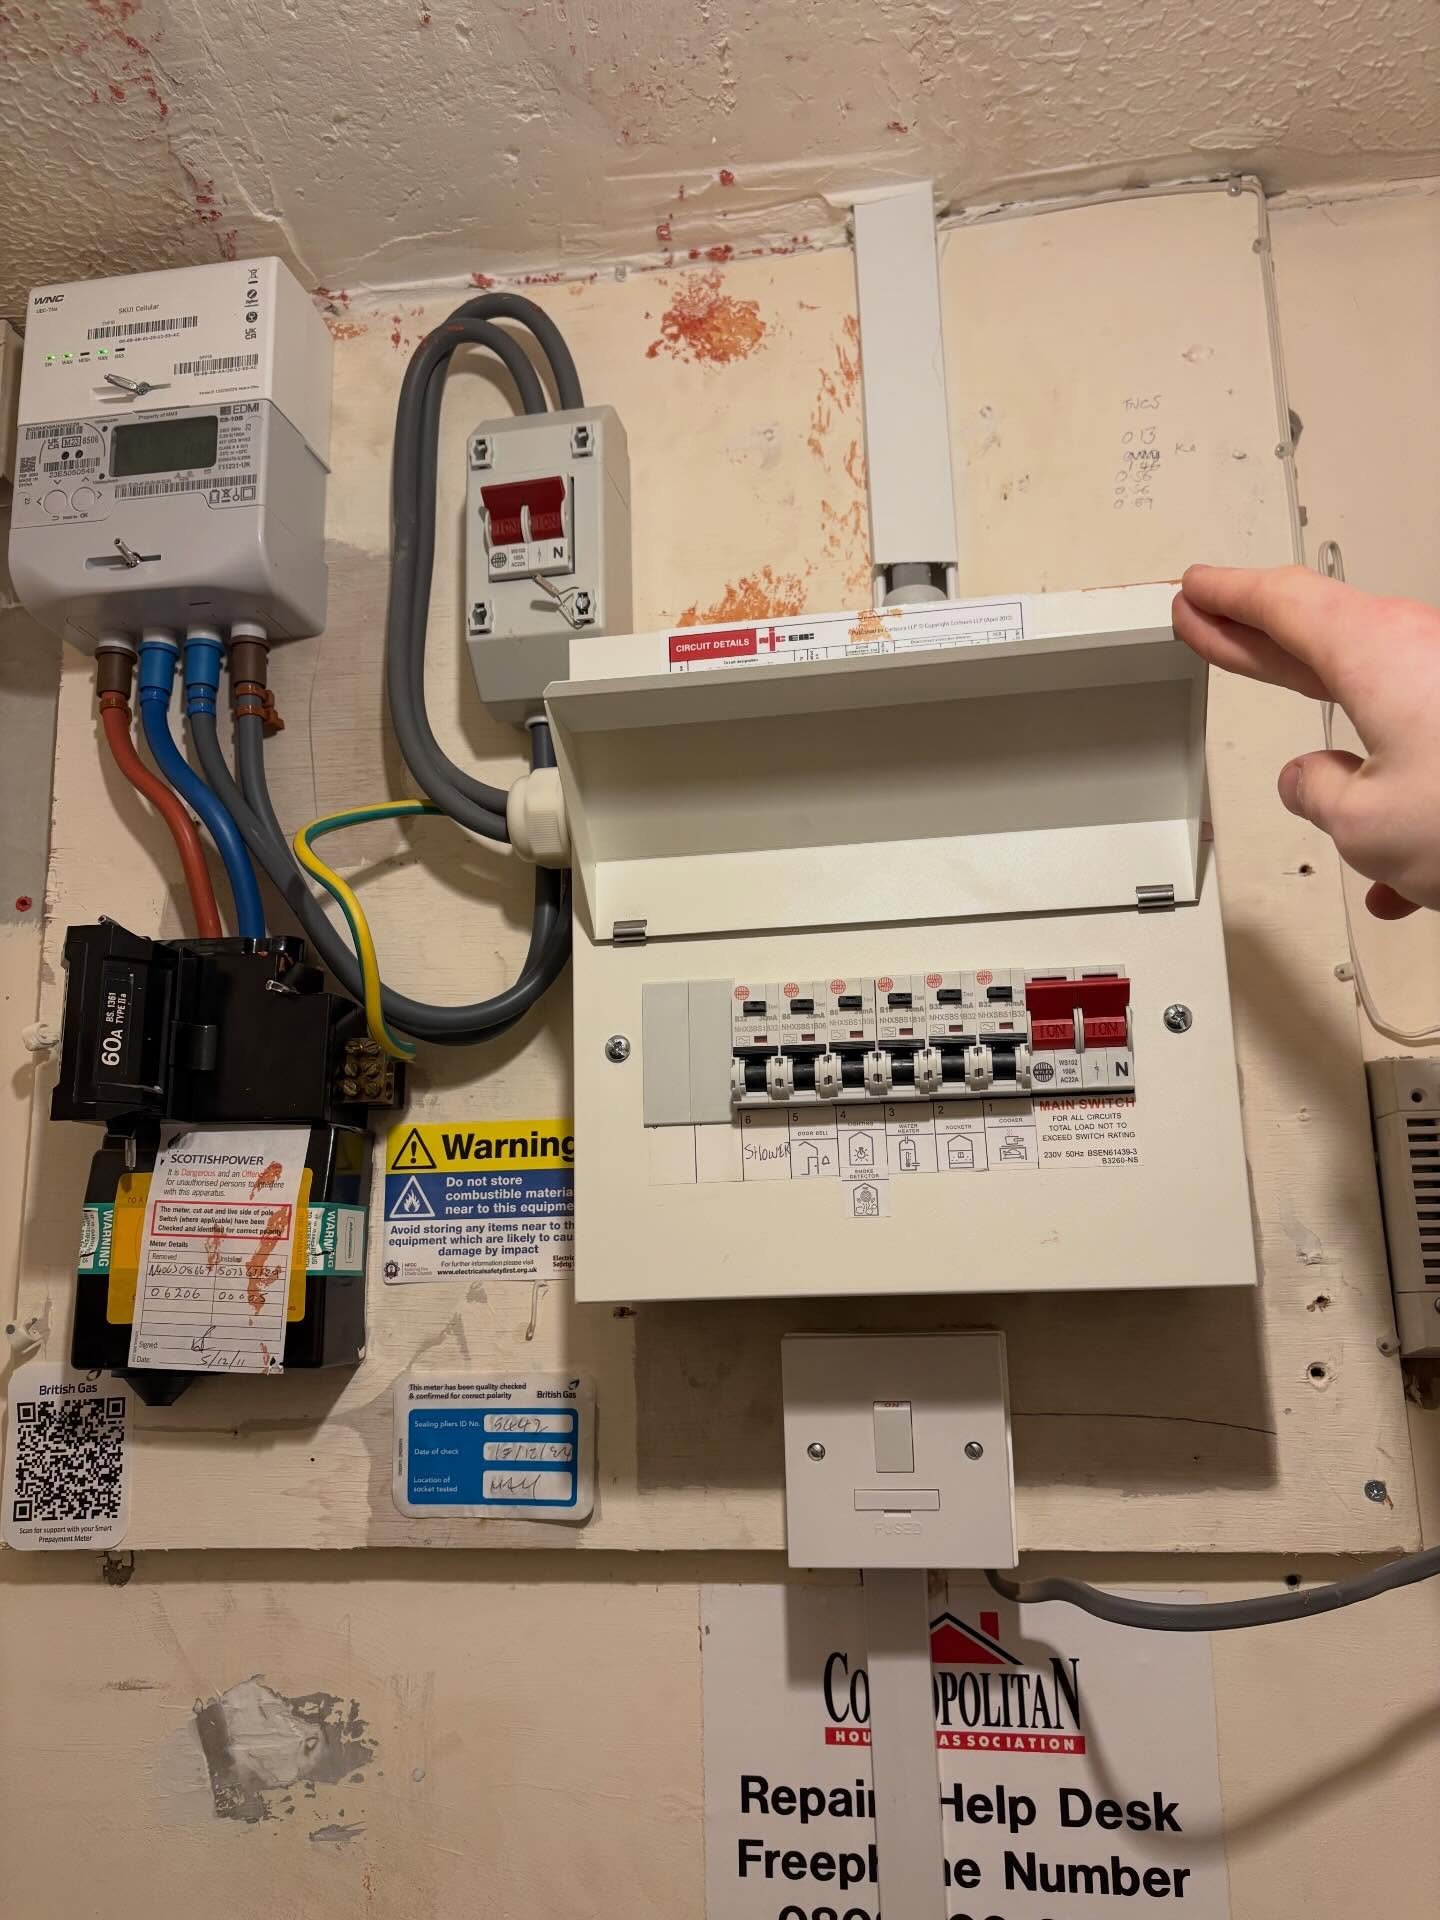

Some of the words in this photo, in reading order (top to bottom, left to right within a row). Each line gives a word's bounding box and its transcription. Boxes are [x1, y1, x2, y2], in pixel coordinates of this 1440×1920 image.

[34, 295, 64, 305] WNC
[233, 403, 259, 414] EDMI
[64, 437, 80, 447] M23
[553, 546, 563, 559] N
[676, 643, 711, 653] CIRCUIT
[713, 638, 750, 649] DETAILS
[107, 992, 116, 1008] 1361
[116, 1005, 126, 1024] TYPE
[978, 1011, 1025, 1019] NHXSBS1B32
[101, 1029, 123, 1066] 60A
[1115, 1061, 1129, 1077] N
[938, 1105, 944, 1114] 2
[988, 1103, 993, 1112] 1
[1039, 1099, 1075, 1112] MAIN
[1079, 1096, 1137, 1110] SWITCH
[792, 1112, 799, 1121] 5
[840, 1111, 846, 1119] 4
[889, 1107, 895, 1116] 3
[1052, 1114, 1068, 1122] FOR
[1087, 1112, 1122, 1120] CIRCUITS
[745, 1115, 752, 1125] 6
[1049, 1124, 1072, 1132] TOTAL
[1074, 1123, 1094, 1131] LOAD
[1042, 1134, 1073, 1142] EXCEED
[441, 1130, 574, 1162] Warning
[744, 1143, 791, 1161] SHOWER
[1043, 1151, 1062, 1159] 230V
[1065, 1150, 1084, 1158] 50Hz
[1087, 1148, 1138, 1157] BSEN61439-3
[170, 1154, 264, 1165] SCOTTISHPOWER
[181, 1168, 216, 1178] Dangerous
[218, 1169, 230, 1177] and
[176, 1179, 218, 1187] unauthorised
[446, 1177, 463, 1187] Do
[467, 1176, 486, 1186] not
[491, 1175, 523, 1186] store
[163, 1188, 177, 1196] with
[178, 1188, 190, 1196] this
[191, 1189, 226, 1198] apparatus.
[445, 1189, 521, 1200] combustible
[526, 1187, 574, 1198] materia
[215, 1207, 226, 1215] and
[261, 1209, 274, 1217] pole
[445, 1204, 474, 1214] near
[477, 1204, 489, 1213] to
[493, 1202, 516, 1213] this
[520, 1201, 574, 1214] equipme
[200, 1217, 234, 1225] applicable)
[391, 1225, 420, 1234] Avoid
[424, 1224, 462, 1234] storing
[466, 1225, 485, 1233] any
[488, 1222, 518, 1232] items
[522, 1223, 547, 1231] near
[550, 1222, 560, 1230] to
[564, 1221, 574, 1230] th
[98, 1209, 114, 1267] WARNING
[389, 1236, 447, 1247] equipment
[450, 1235, 482, 1243] which
[486, 1235, 503, 1243] are
[507, 1233, 535, 1244] likely
[539, 1233, 550, 1241] to
[553, 1233, 573, 1241] cau
[438, 1247, 481, 1257] damage
[485, 1245, 498, 1256] by
[501, 1244, 539, 1256] impact
[39, 1384, 75, 1395] British
[78, 1383, 98, 1393] Gas
[475, 1383, 499, 1392] quality
[486, 1391, 512, 1400] polarity
[536, 1390, 562, 1399] British
[562, 1390, 577, 1399] Gas
[414, 1420, 438, 1428] Sealing
[440, 1420, 458, 1428] pliers
[823, 1651, 1080, 1730] COPOLITAN
[835, 1731, 871, 1743] HOU
[939, 1734, 1075, 1750] ASSOCIATION
[940, 1782, 1037, 1834] Help
[1059, 1787, 1184, 1832] Desk
[1004, 1850, 1191, 1898] Number
